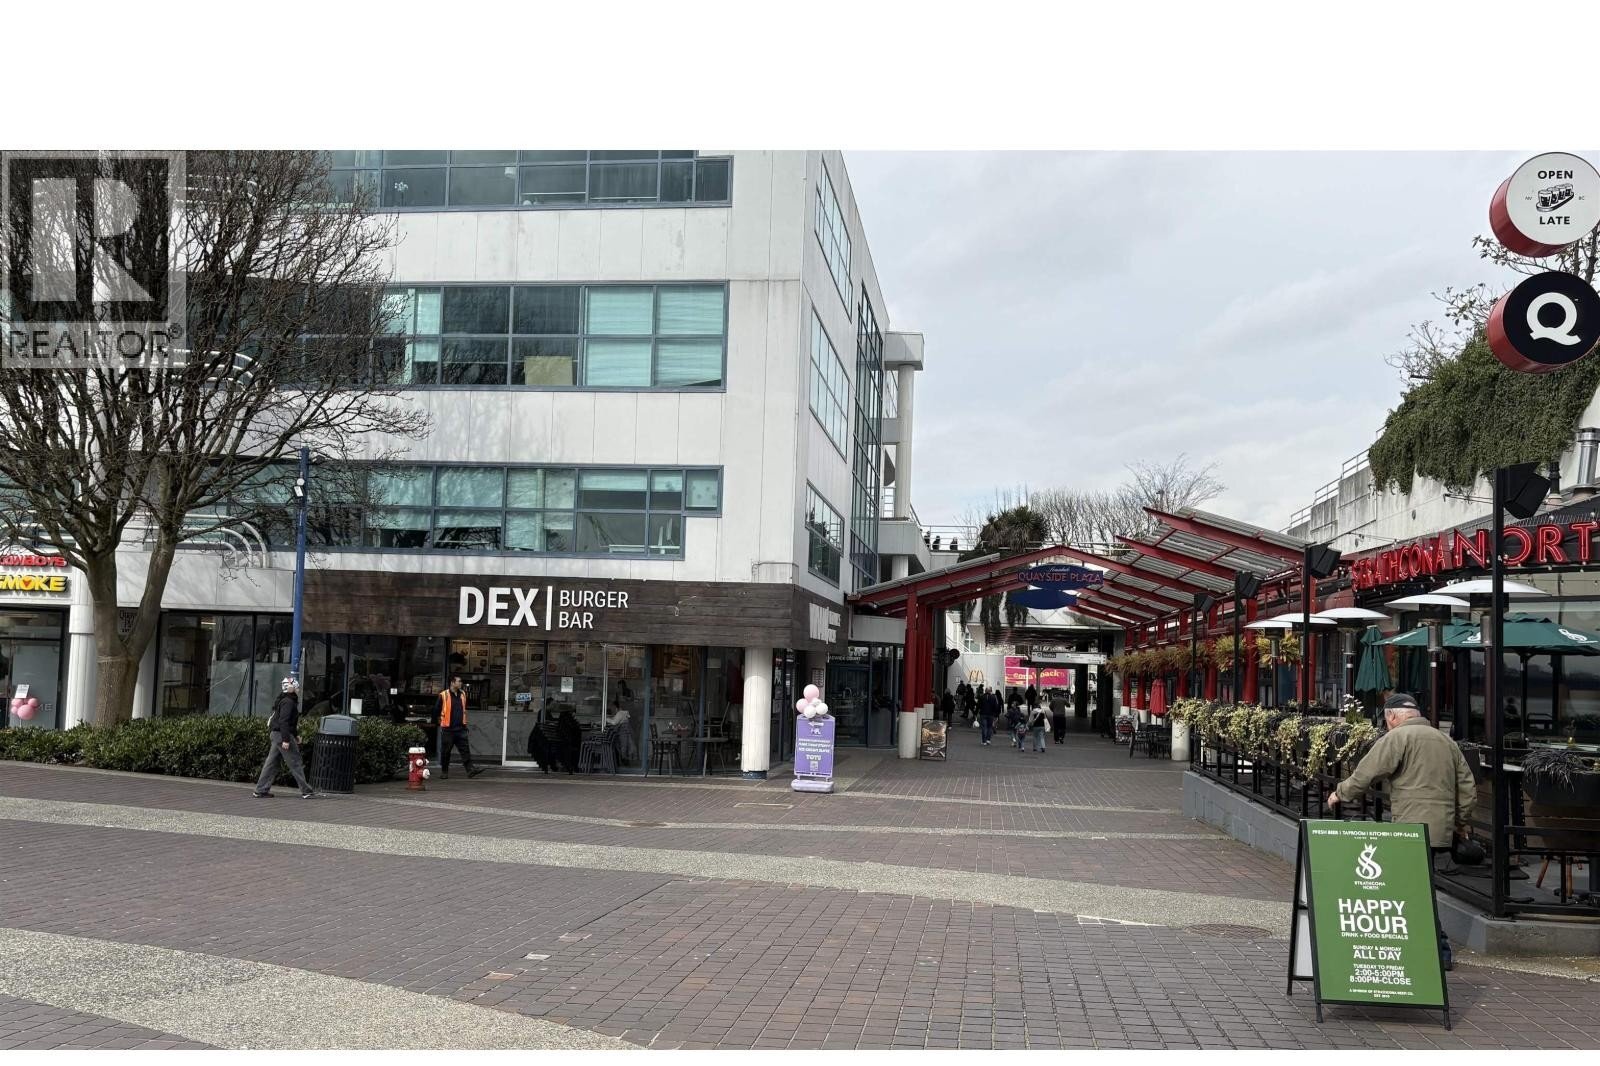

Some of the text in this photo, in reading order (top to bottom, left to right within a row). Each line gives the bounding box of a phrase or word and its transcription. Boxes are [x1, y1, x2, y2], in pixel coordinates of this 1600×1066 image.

[1537, 170, 1573, 179] OPEN
[1539, 216, 1571, 225] LATE
[1526, 292, 1582, 346] Q
[1452, 521, 1599, 571] NORT
[1018, 572, 1102, 583] QUAYSIDE PLAZA
[458, 586, 629, 627] DEX BURGER
[558, 611, 594, 629] BAR
[1338, 898, 1405, 915] HAPPY
[1340, 914, 1408, 934] HOUR
[1353, 950, 1402, 960] ALL DAY
[1354, 968, 1405, 977] 2:00-5:00PM
